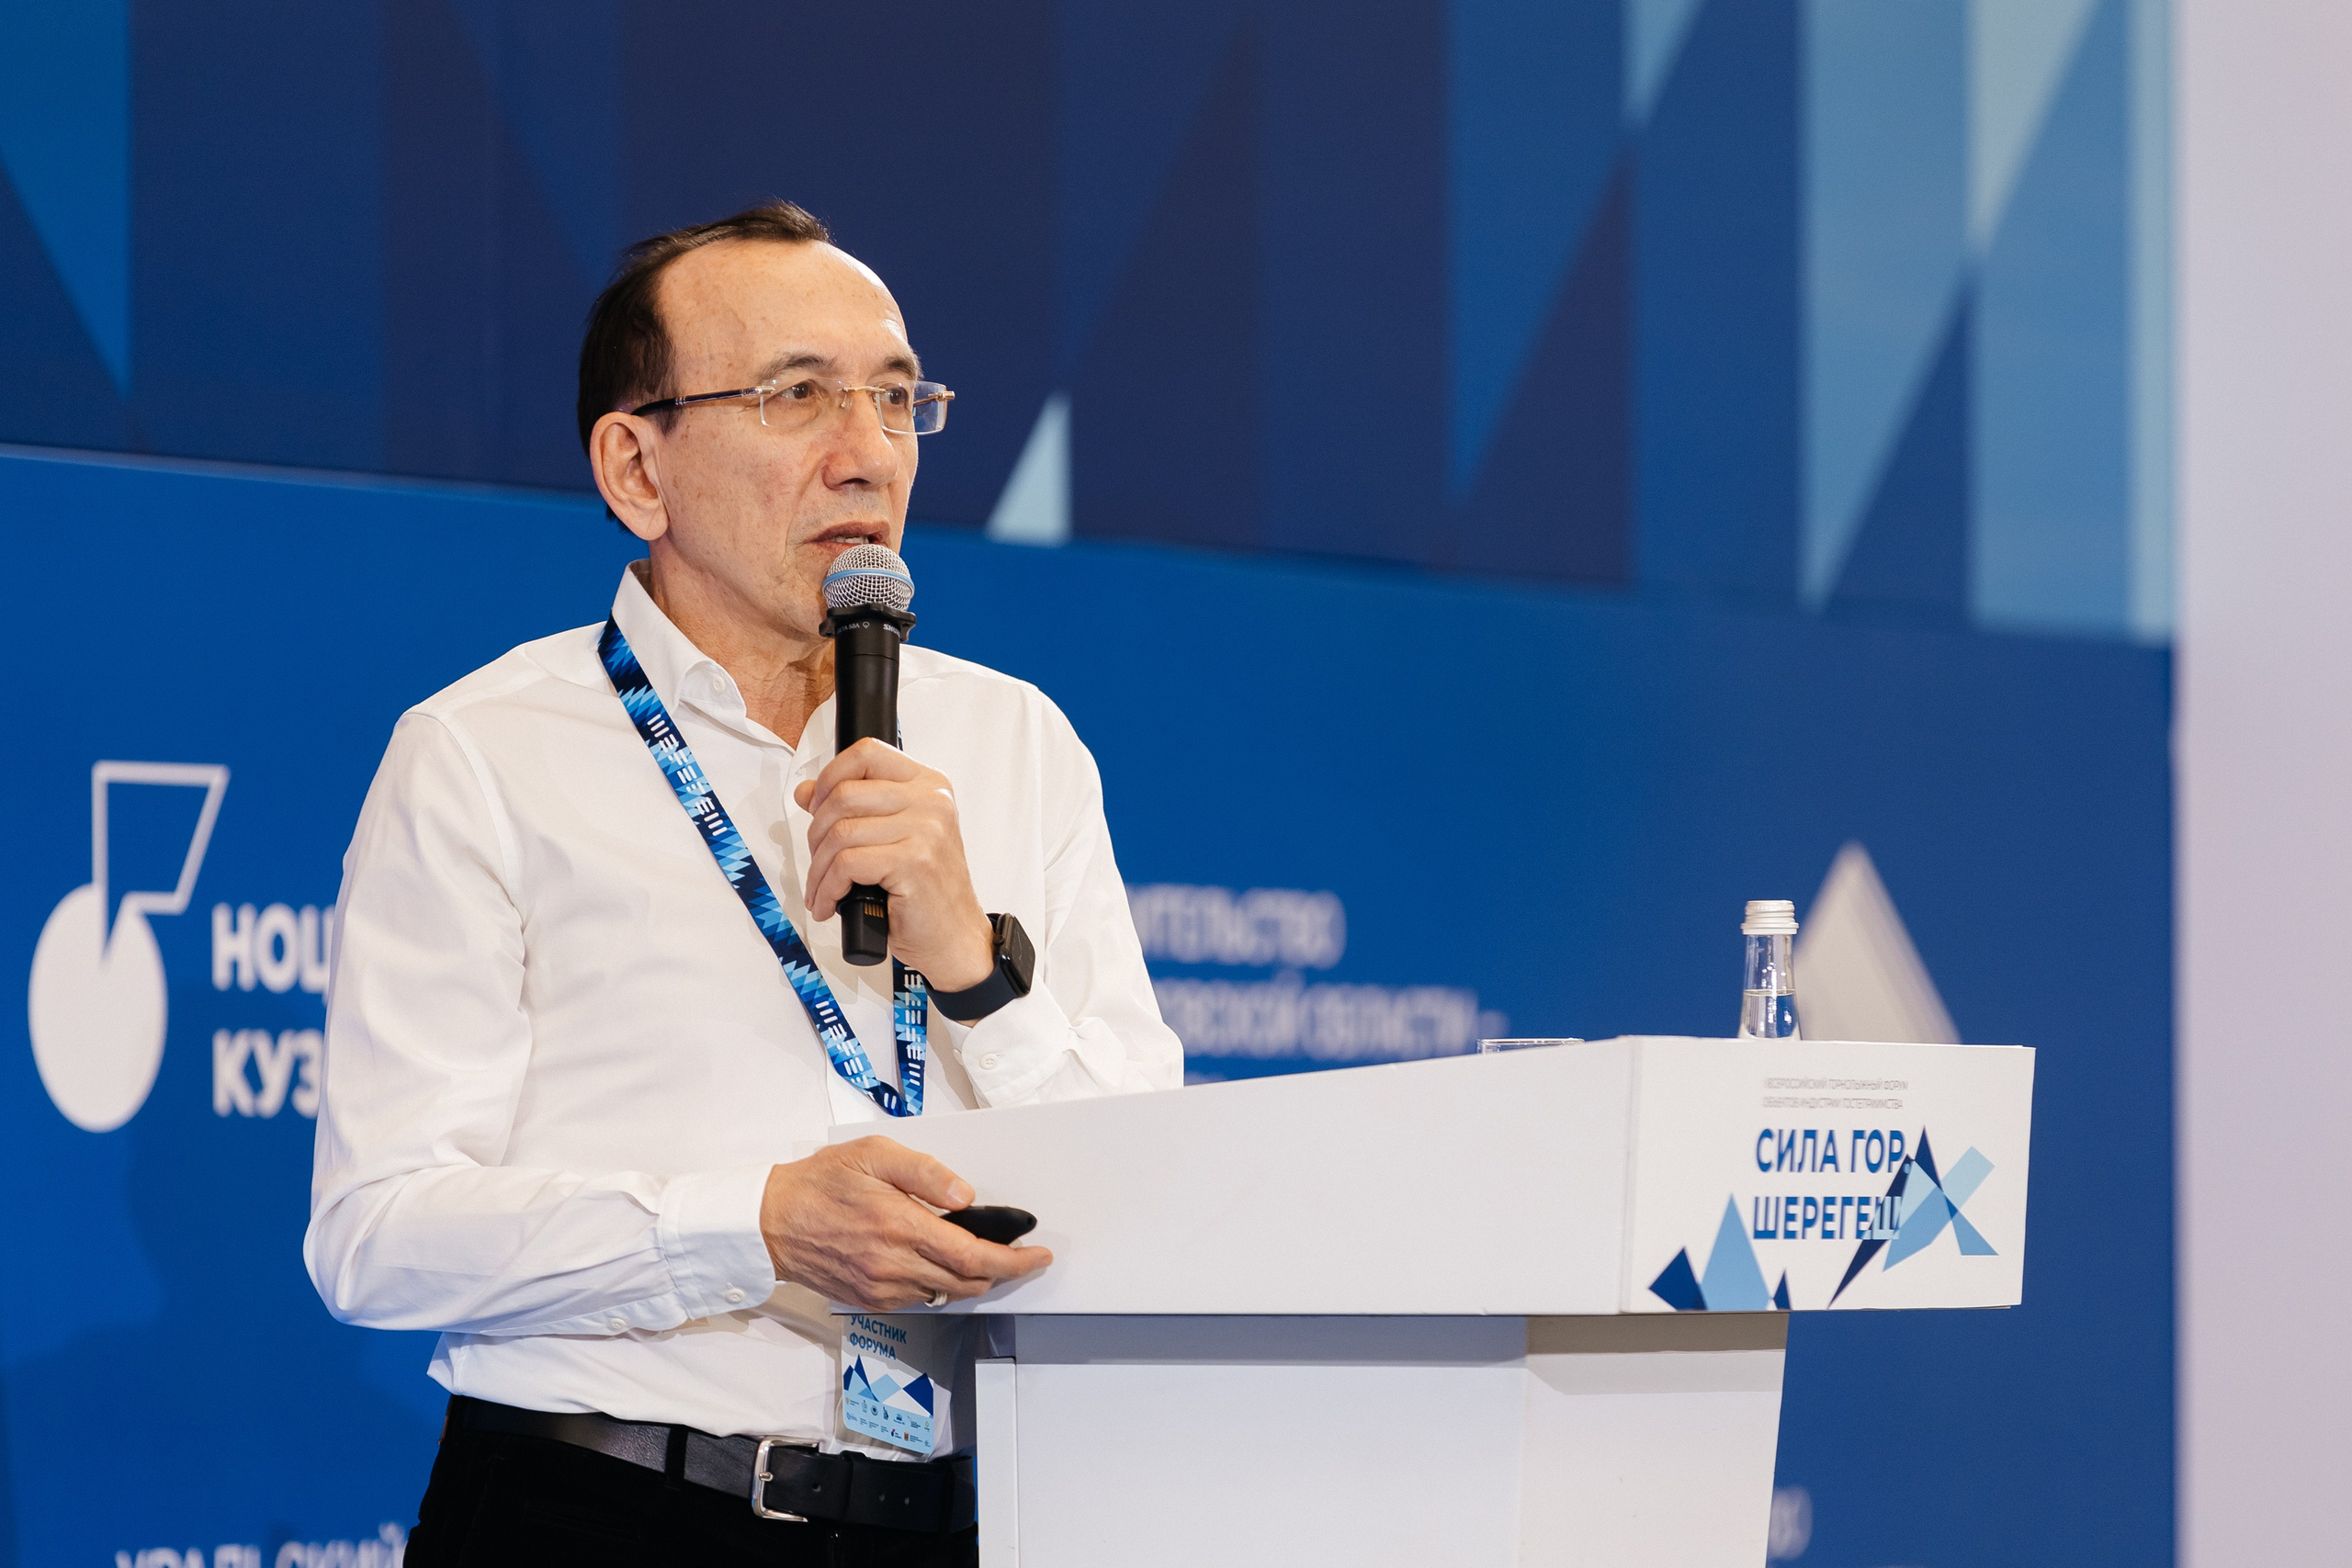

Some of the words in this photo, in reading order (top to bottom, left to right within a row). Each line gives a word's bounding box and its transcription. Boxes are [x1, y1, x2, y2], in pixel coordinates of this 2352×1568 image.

[212, 902, 335, 1006] НОЦ
[1756, 1129, 1840, 1174] СИЛА
[1754, 1197, 1900, 1240] ШЕРЕГЕШ
[849, 1331, 897, 1360] ФОРУМА
[850, 1314, 908, 1345] УЧАСТНИК
